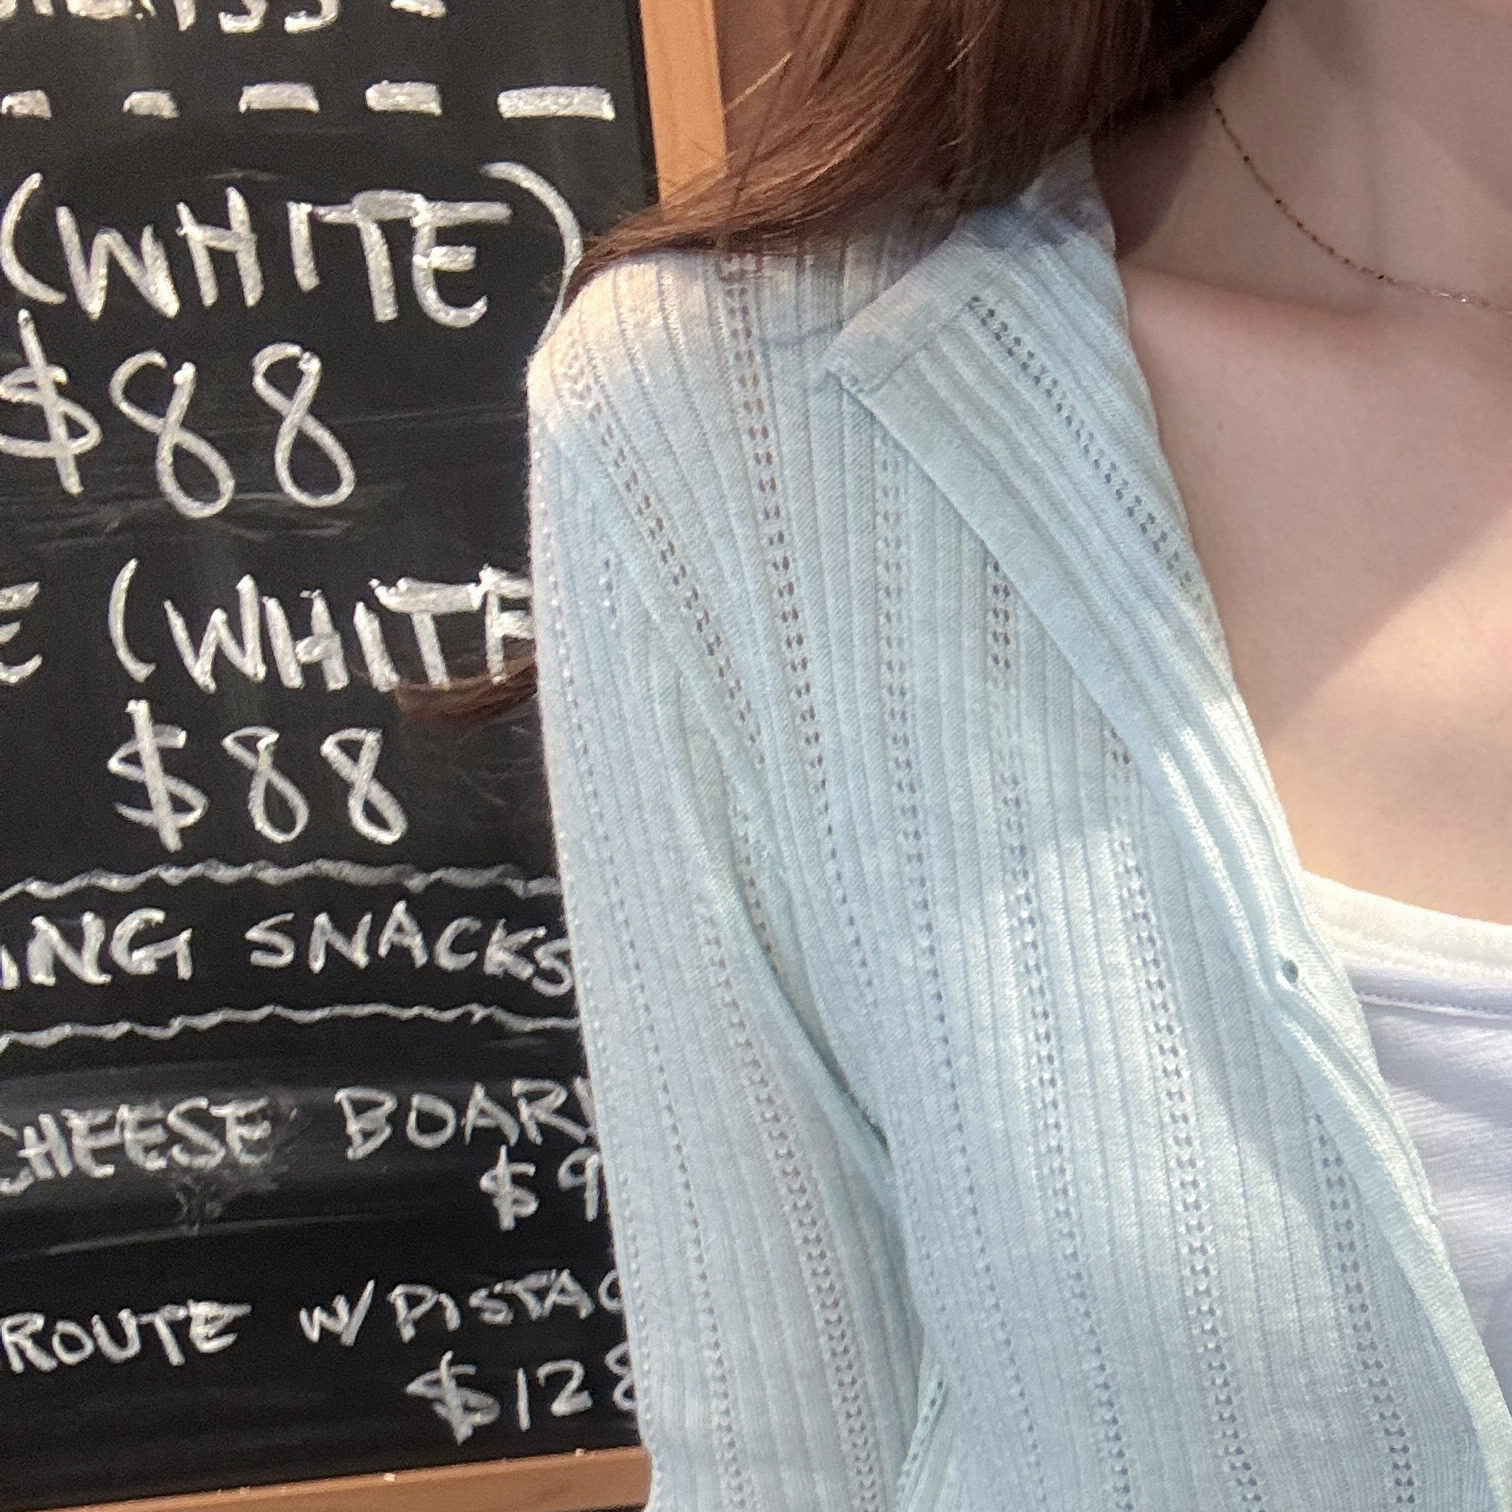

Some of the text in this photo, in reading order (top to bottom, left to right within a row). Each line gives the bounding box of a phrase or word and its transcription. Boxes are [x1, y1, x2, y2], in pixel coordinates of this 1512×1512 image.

[2, 162, 584, 352] (WHITE)
[0, 309, 355, 519] $88
[108, 700, 407, 851] $88
[245, 899, 572, 996] SNACKS
[0, 1299, 252, 1373] ROUTE
